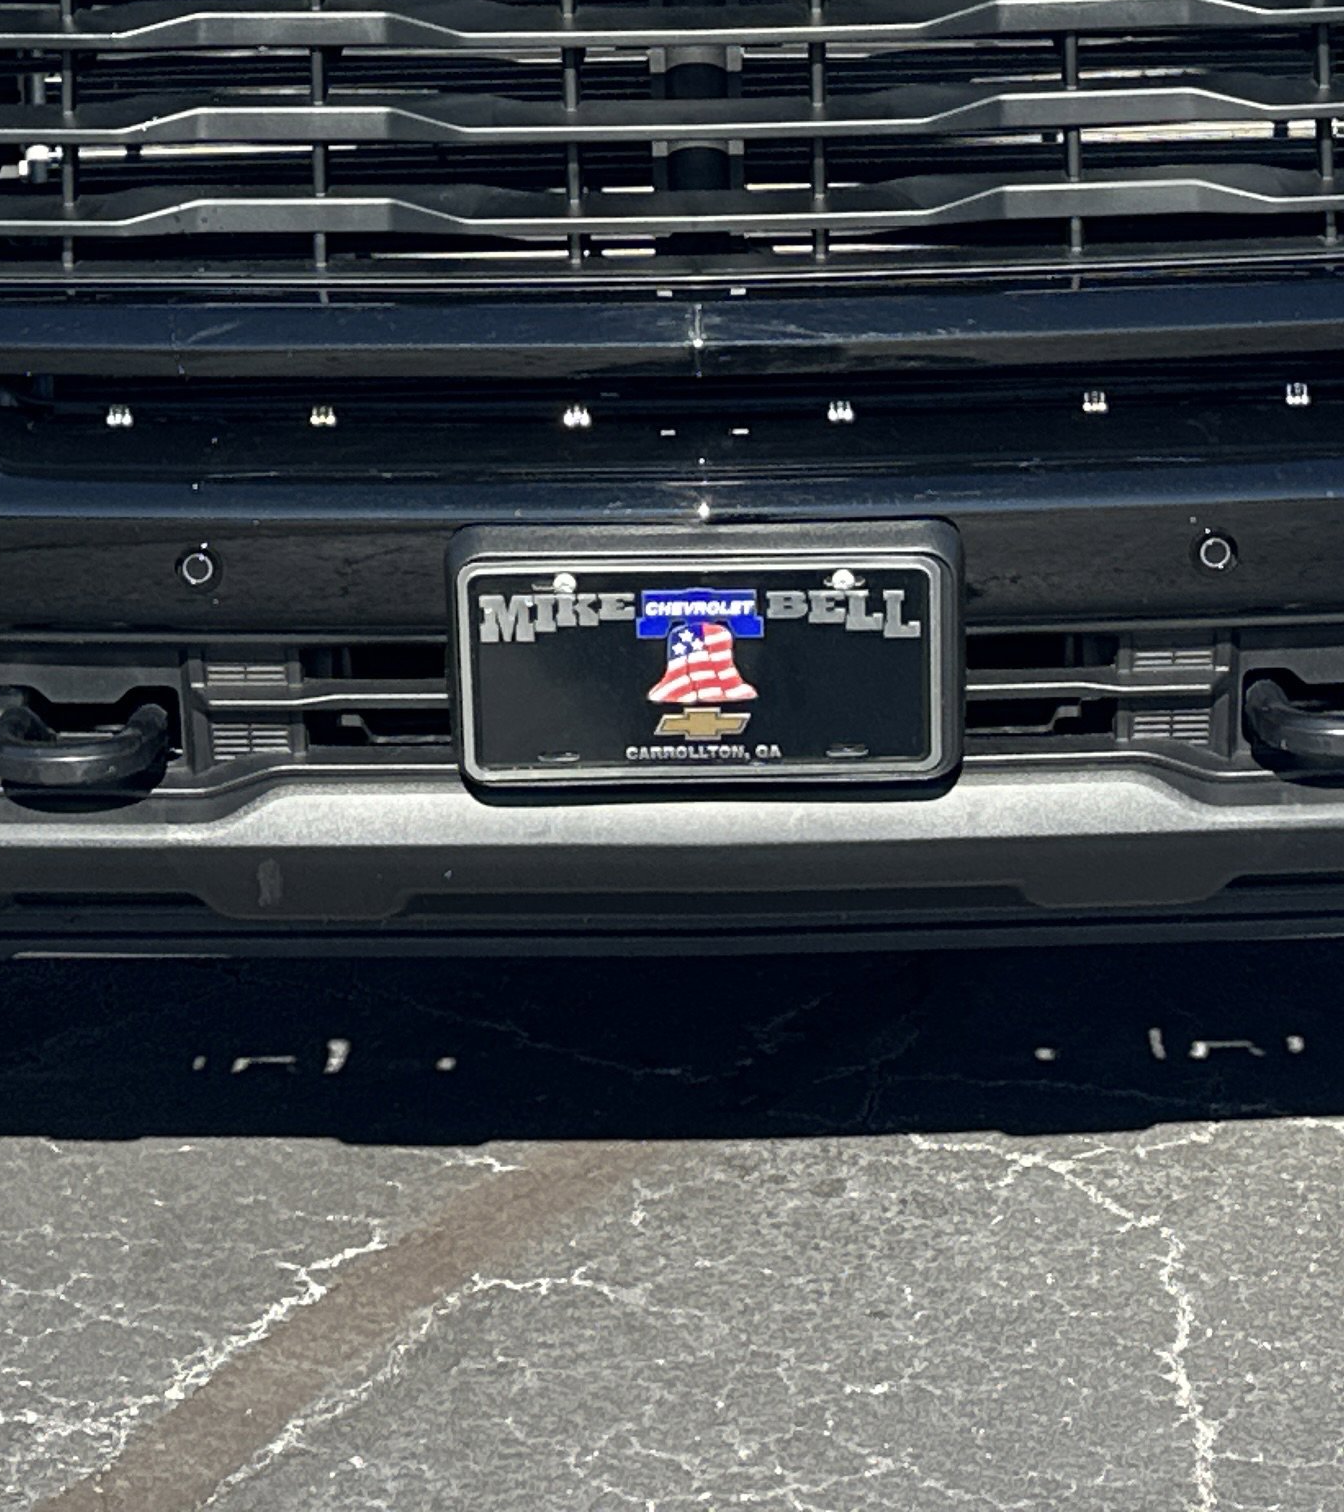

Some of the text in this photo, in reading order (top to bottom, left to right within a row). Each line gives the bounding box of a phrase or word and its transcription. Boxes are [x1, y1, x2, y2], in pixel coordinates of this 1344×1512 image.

[478, 588, 921, 643] MIKE BELL
[644, 599, 754, 617] CHEVROLET
[625, 745, 783, 761] CARROLLTON, GA
